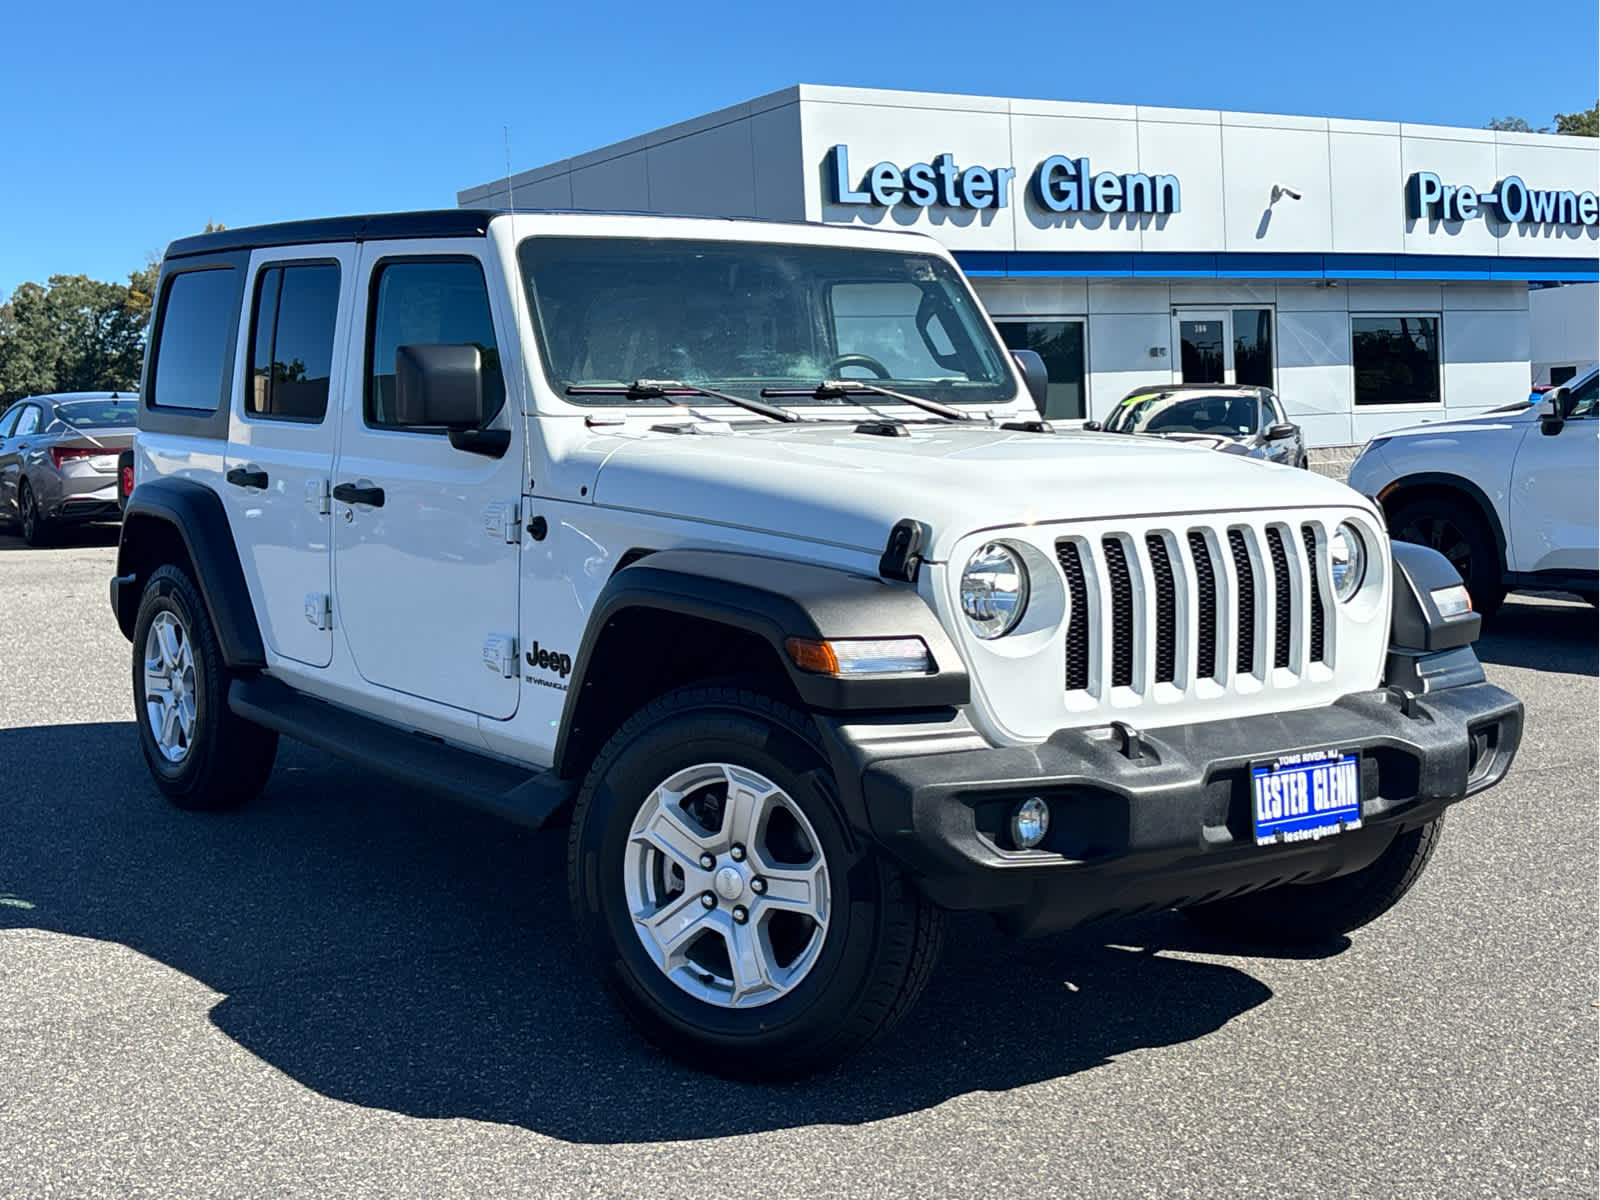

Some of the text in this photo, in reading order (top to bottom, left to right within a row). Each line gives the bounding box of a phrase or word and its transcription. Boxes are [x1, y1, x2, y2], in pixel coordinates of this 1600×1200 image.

[828, 144, 1181, 214] Lester Glenn
[1411, 171, 1599, 225] Pre-Owne
[526, 640, 571, 679] Jeep
[533, 678, 568, 691] WRANGLE
[1279, 755, 1300, 765] TOMS
[1256, 764, 1357, 820] LESTER GLENN
